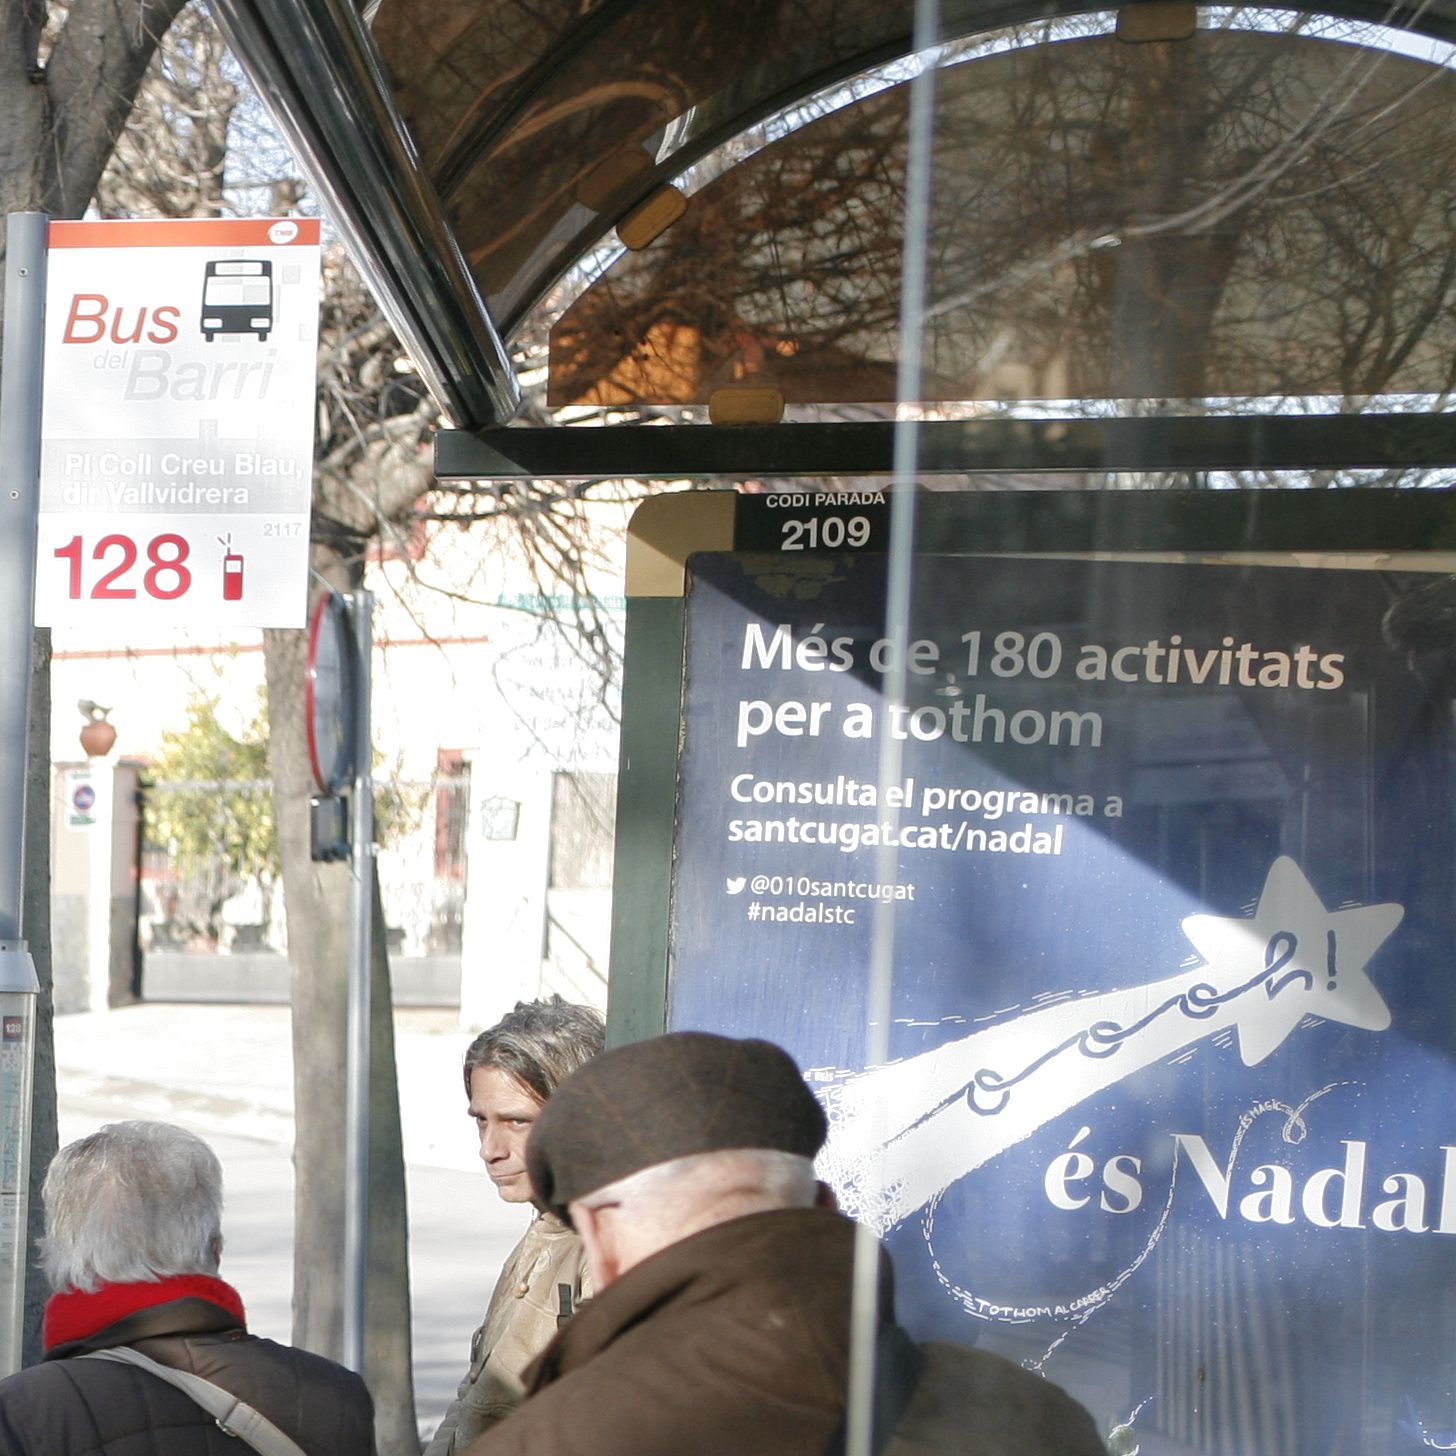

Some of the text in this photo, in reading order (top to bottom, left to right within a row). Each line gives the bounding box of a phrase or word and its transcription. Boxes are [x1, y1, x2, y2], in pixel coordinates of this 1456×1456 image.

[62, 293, 181, 344] Bus
[93, 348, 278, 402] del Barri
[64, 453, 304, 481] Pl Coll Creu Blau,
[103, 482, 249, 506] Vallvidrera
[766, 492, 886, 509] CODI PARADA
[262, 522, 302, 538] 2117
[781, 515, 871, 552] 2109
[53, 533, 192, 600] 128
[741, 622, 1345, 691] Més de 180 activitats
[737, 693, 1102, 748] per a tothom
[730, 773, 1124, 820] Consulta el programa a
[727, 815, 1064, 856] santcugat.cat/nadal
[750, 875, 915, 904] @010santcugat
[747, 901, 856, 925] #nadalstc
[1044, 1126, 1456, 1235] és Nadal
[975, 1296, 1053, 1319] TOTHOM
[1054, 1305, 1071, 1316] AL
